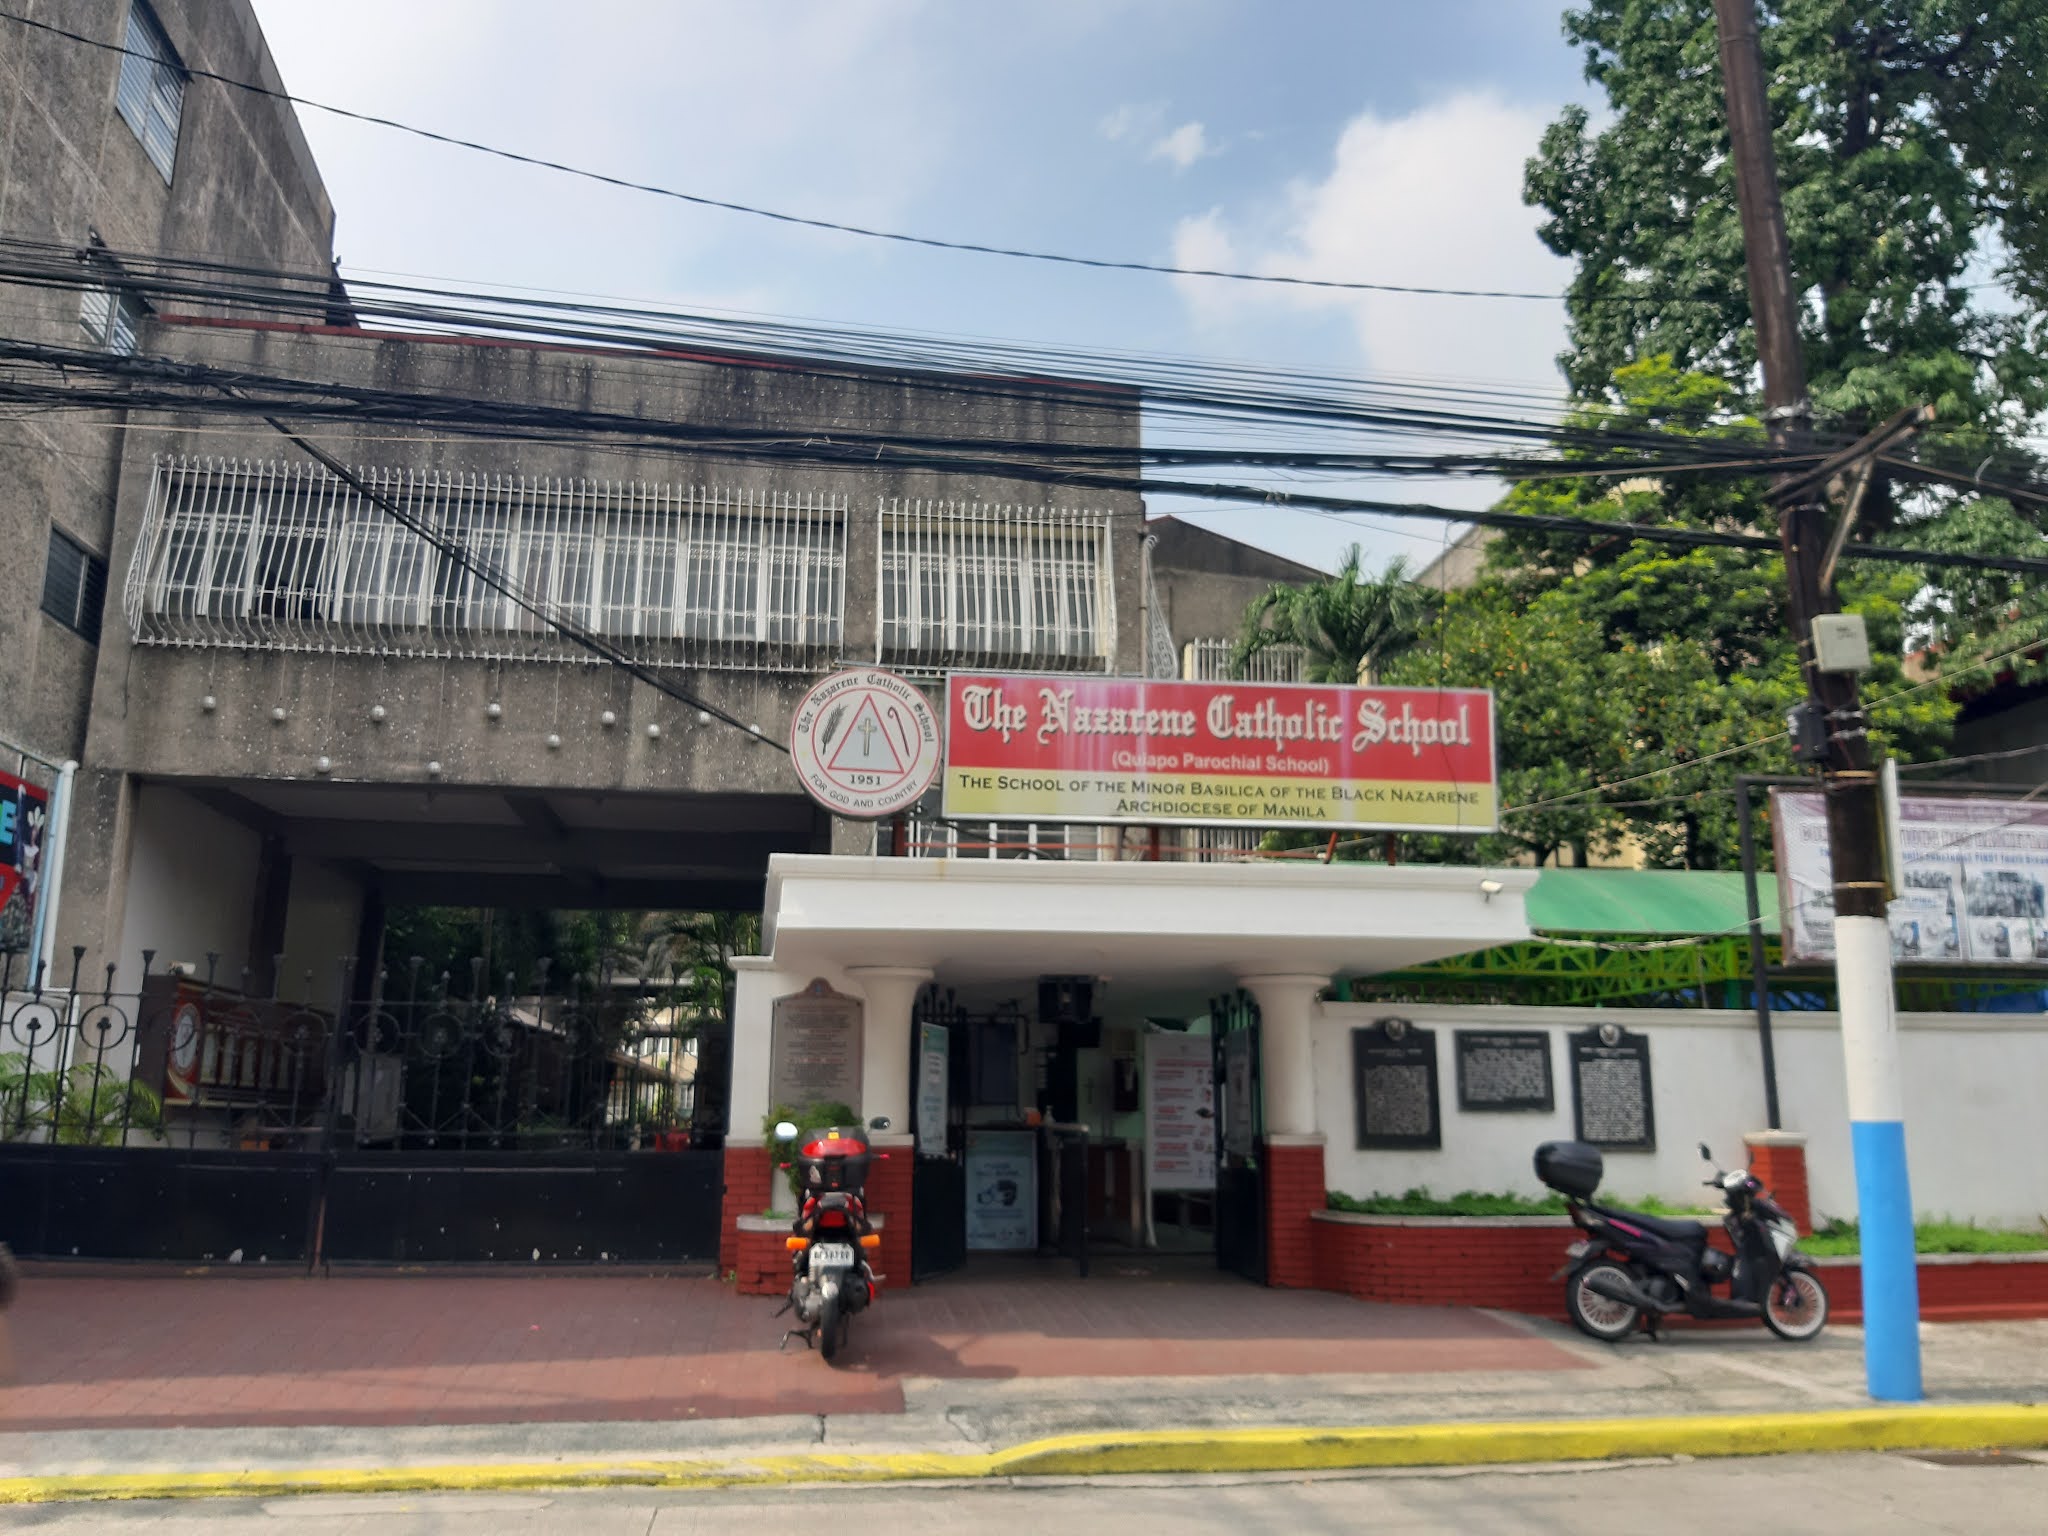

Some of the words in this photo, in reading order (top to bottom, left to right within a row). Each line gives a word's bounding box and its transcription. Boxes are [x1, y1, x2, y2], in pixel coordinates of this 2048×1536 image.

[798, 711, 813, 734] The
[811, 677, 859, 706] Nazarene
[867, 673, 912, 701] Catholic
[913, 702, 935, 743] School
[961, 684, 1027, 744] The
[1036, 687, 1196, 745] Nazarene
[1206, 694, 1344, 752] Catholic
[1352, 698, 1472, 757] School
[850, 774, 882, 786] 1951
[1112, 751, 1179, 770] (Quiapo
[1183, 752, 1261, 770] Parochial
[1266, 757, 1329, 776] School)
[810, 774, 828, 792] FOR
[829, 791, 850, 805] GOD
[853, 799, 874, 808] AND
[878, 780, 917, 806] COUNTRY
[0, 799, 17, 845] E
